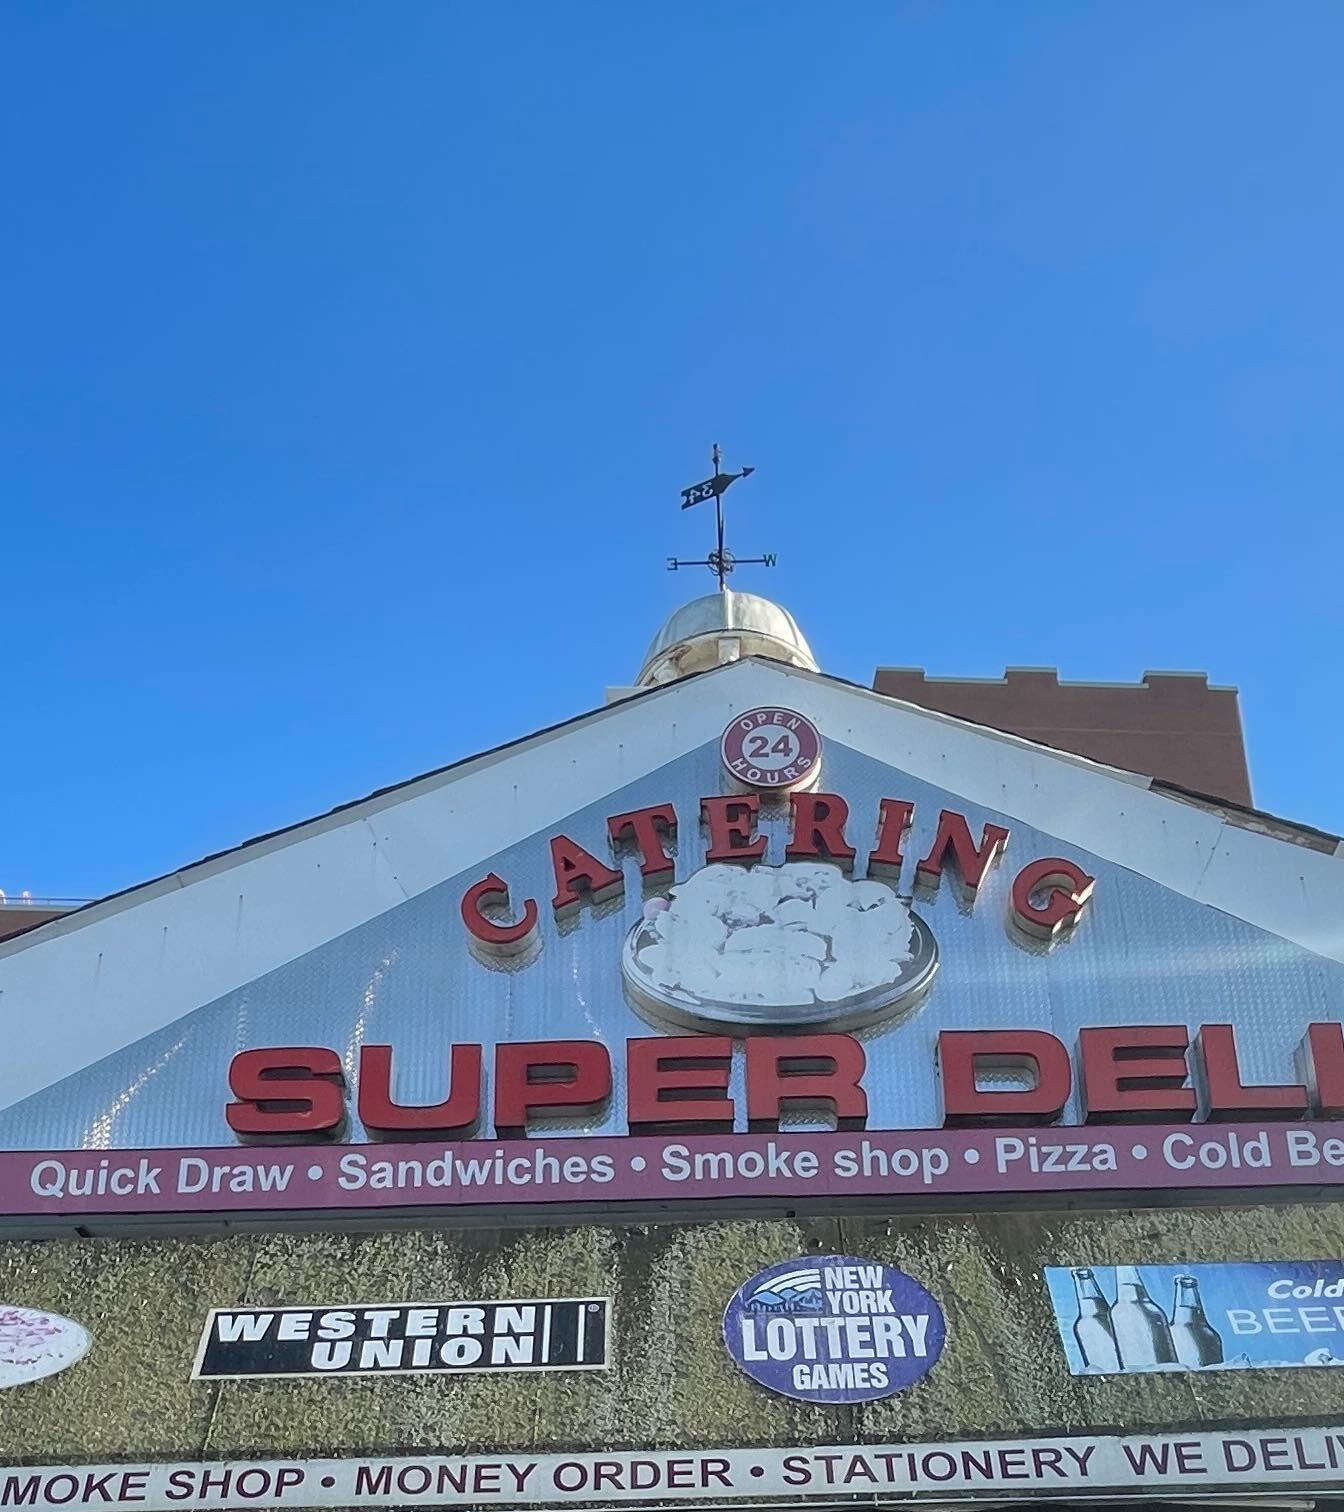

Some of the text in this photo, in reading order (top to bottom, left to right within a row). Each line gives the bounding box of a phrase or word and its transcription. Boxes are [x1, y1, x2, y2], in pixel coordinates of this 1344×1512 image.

[740, 713, 801, 730] OPEN
[749, 735, 793, 758] 24
[731, 757, 811, 784] HOURS
[461, 791, 1096, 948] CATERING
[225, 1033, 868, 1142] SUPER
[29, 1157, 161, 1199] Quick
[176, 1161, 293, 1195] Draw
[337, 1151, 615, 1191] Sandwiches
[660, 1143, 820, 1182] Smoke
[834, 1143, 949, 1184] shop
[996, 1135, 1117, 1174] Pizza
[1163, 1129, 1273, 1170] Cold
[823, 1266, 884, 1289] NEW
[827, 1290, 895, 1315] YORK
[215, 1306, 537, 1341] WESTERN
[742, 1316, 929, 1361] LOTTERY
[311, 1335, 534, 1369] UNION
[792, 1362, 889, 1390] GAMES
[166, 1467, 305, 1501] SHOP
[355, 1463, 537, 1496] MONEY
[551, 1457, 732, 1492] ORDER
[782, 1445, 1096, 1486] STATIONERY
[1123, 1440, 1207, 1475] WE
